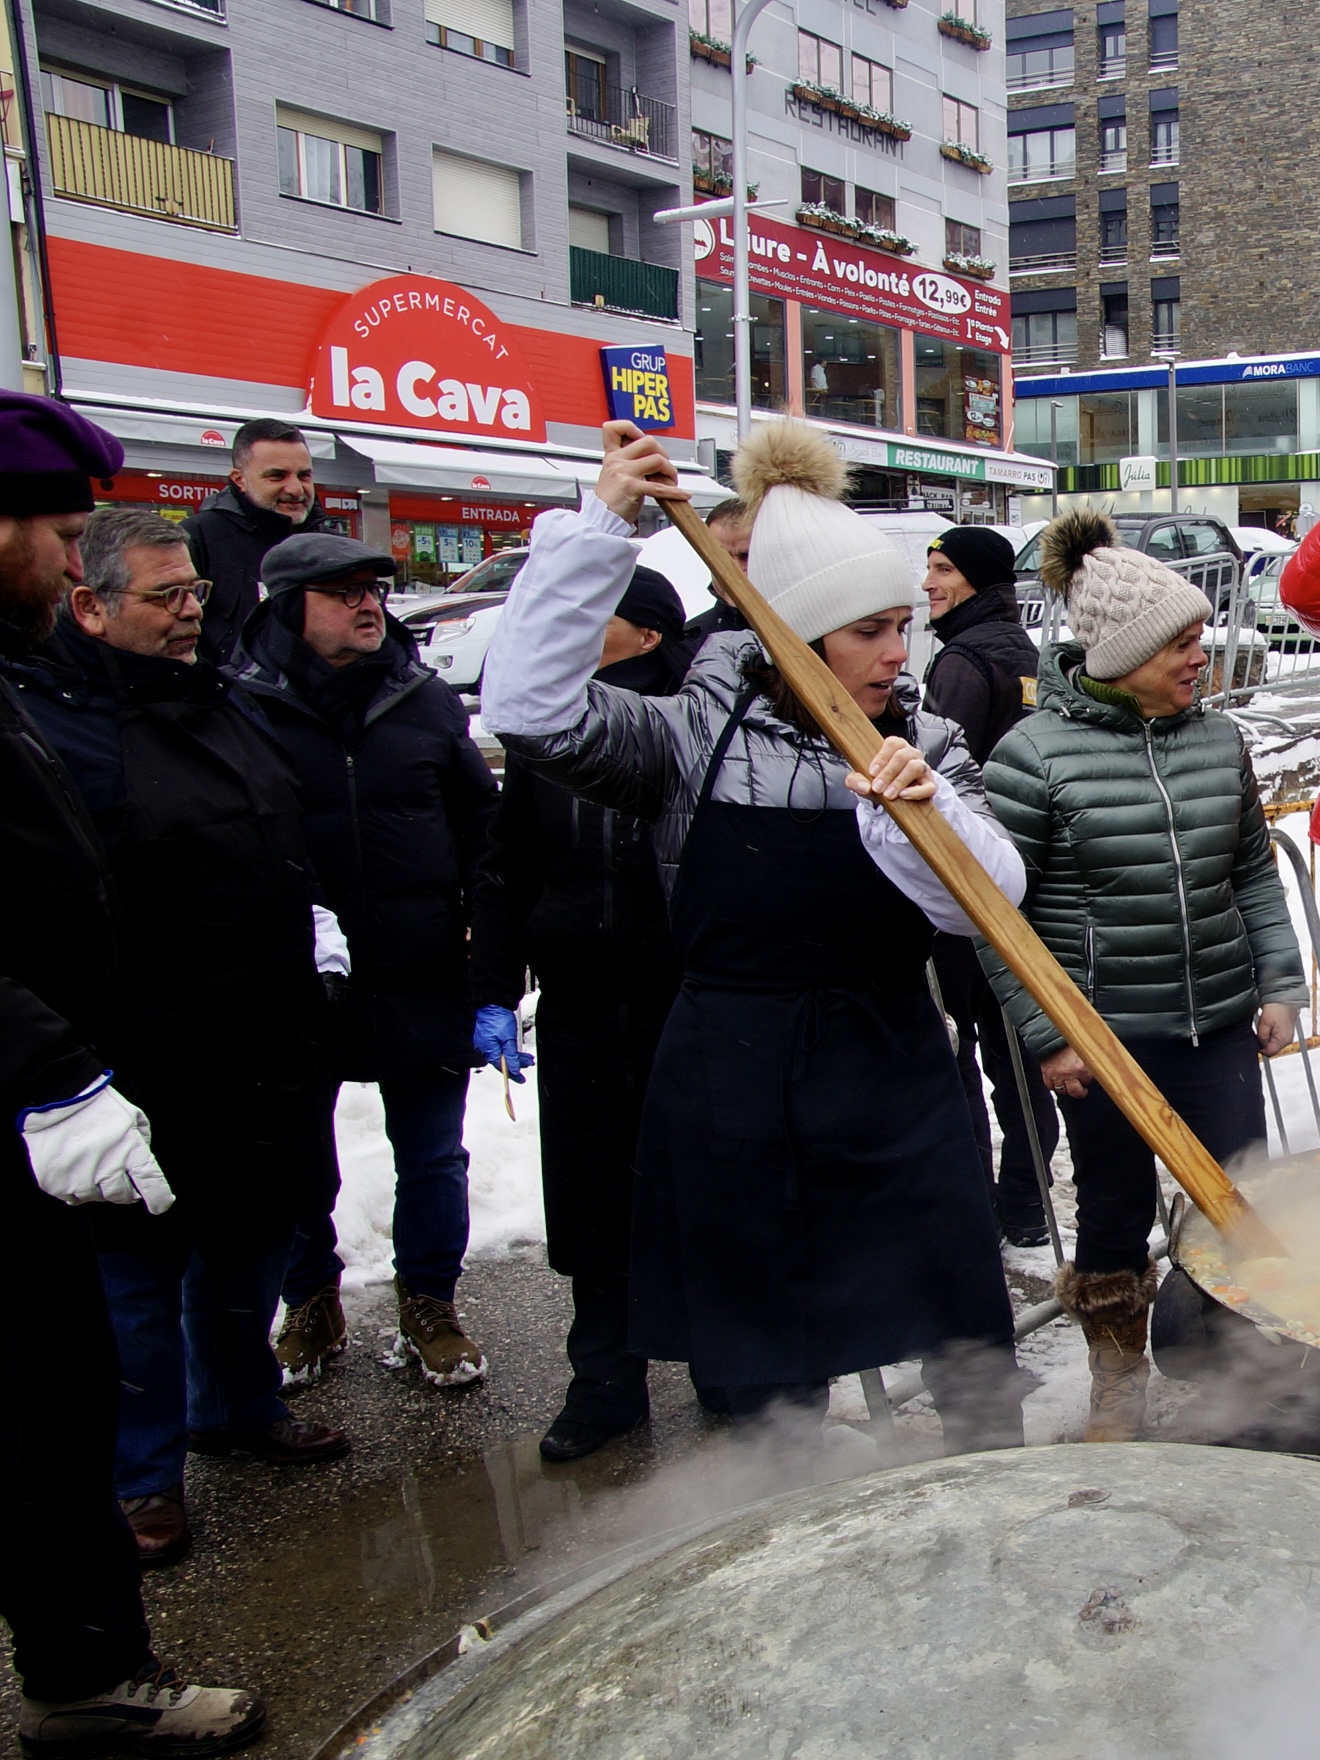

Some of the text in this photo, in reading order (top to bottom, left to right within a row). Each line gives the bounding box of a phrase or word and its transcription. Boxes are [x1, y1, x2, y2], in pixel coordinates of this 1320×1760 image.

[833, 258, 910, 297] volonté
[918, 277, 967, 309] 12,99€
[974, 302, 998, 317] Entrée
[353, 291, 509, 361] SUPERMERCAT
[631, 352, 666, 372] GRUP
[330, 345, 532, 431] la Cava
[611, 366, 669, 399] HIPER
[633, 393, 671, 422] PAS
[895, 448, 979, 475] RESTAURANT
[988, 466, 1036, 482] TAMARRO PAS
[1123, 463, 1151, 488] Júlia
[461, 507, 520, 523] ENTRADA
